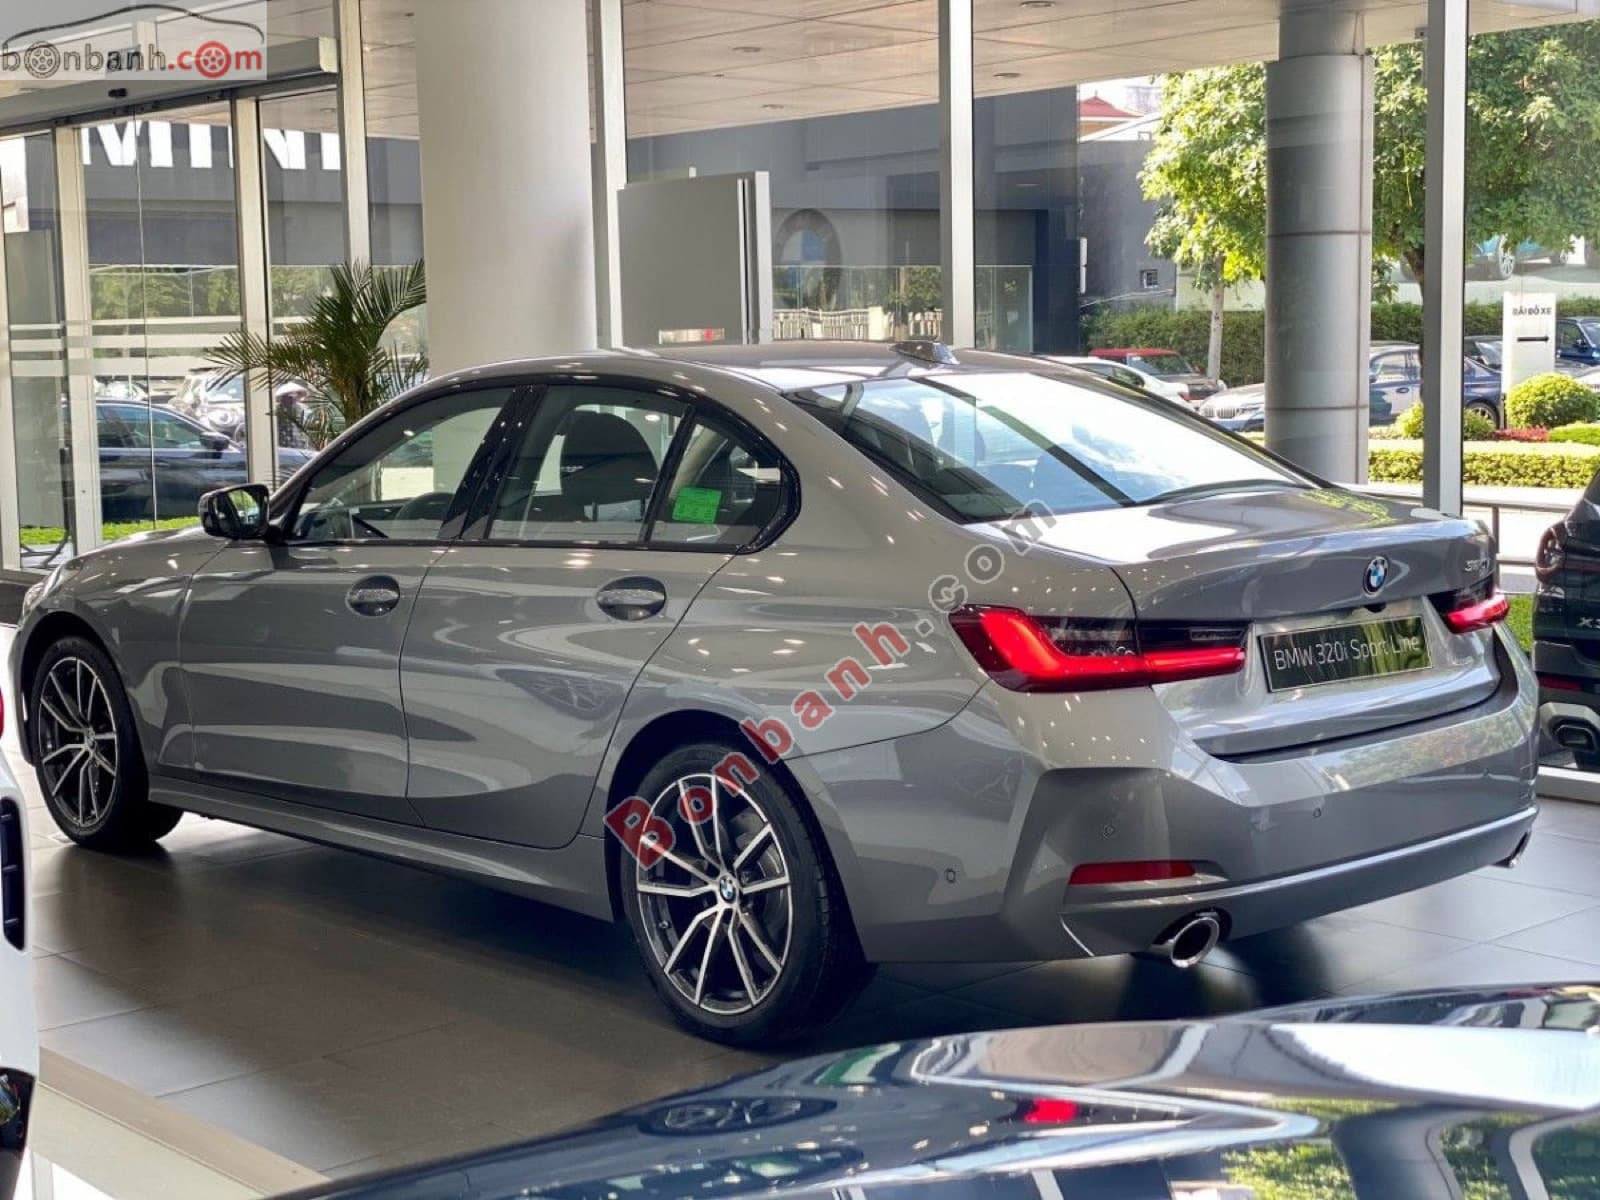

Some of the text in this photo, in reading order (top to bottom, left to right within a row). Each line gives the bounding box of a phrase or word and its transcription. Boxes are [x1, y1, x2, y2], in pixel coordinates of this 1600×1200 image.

[1541, 306, 1552, 315] XE
[1274, 645, 1313, 670] BMW
[1315, 641, 1349, 664] 320i
[1350, 639, 1389, 662] Sport
